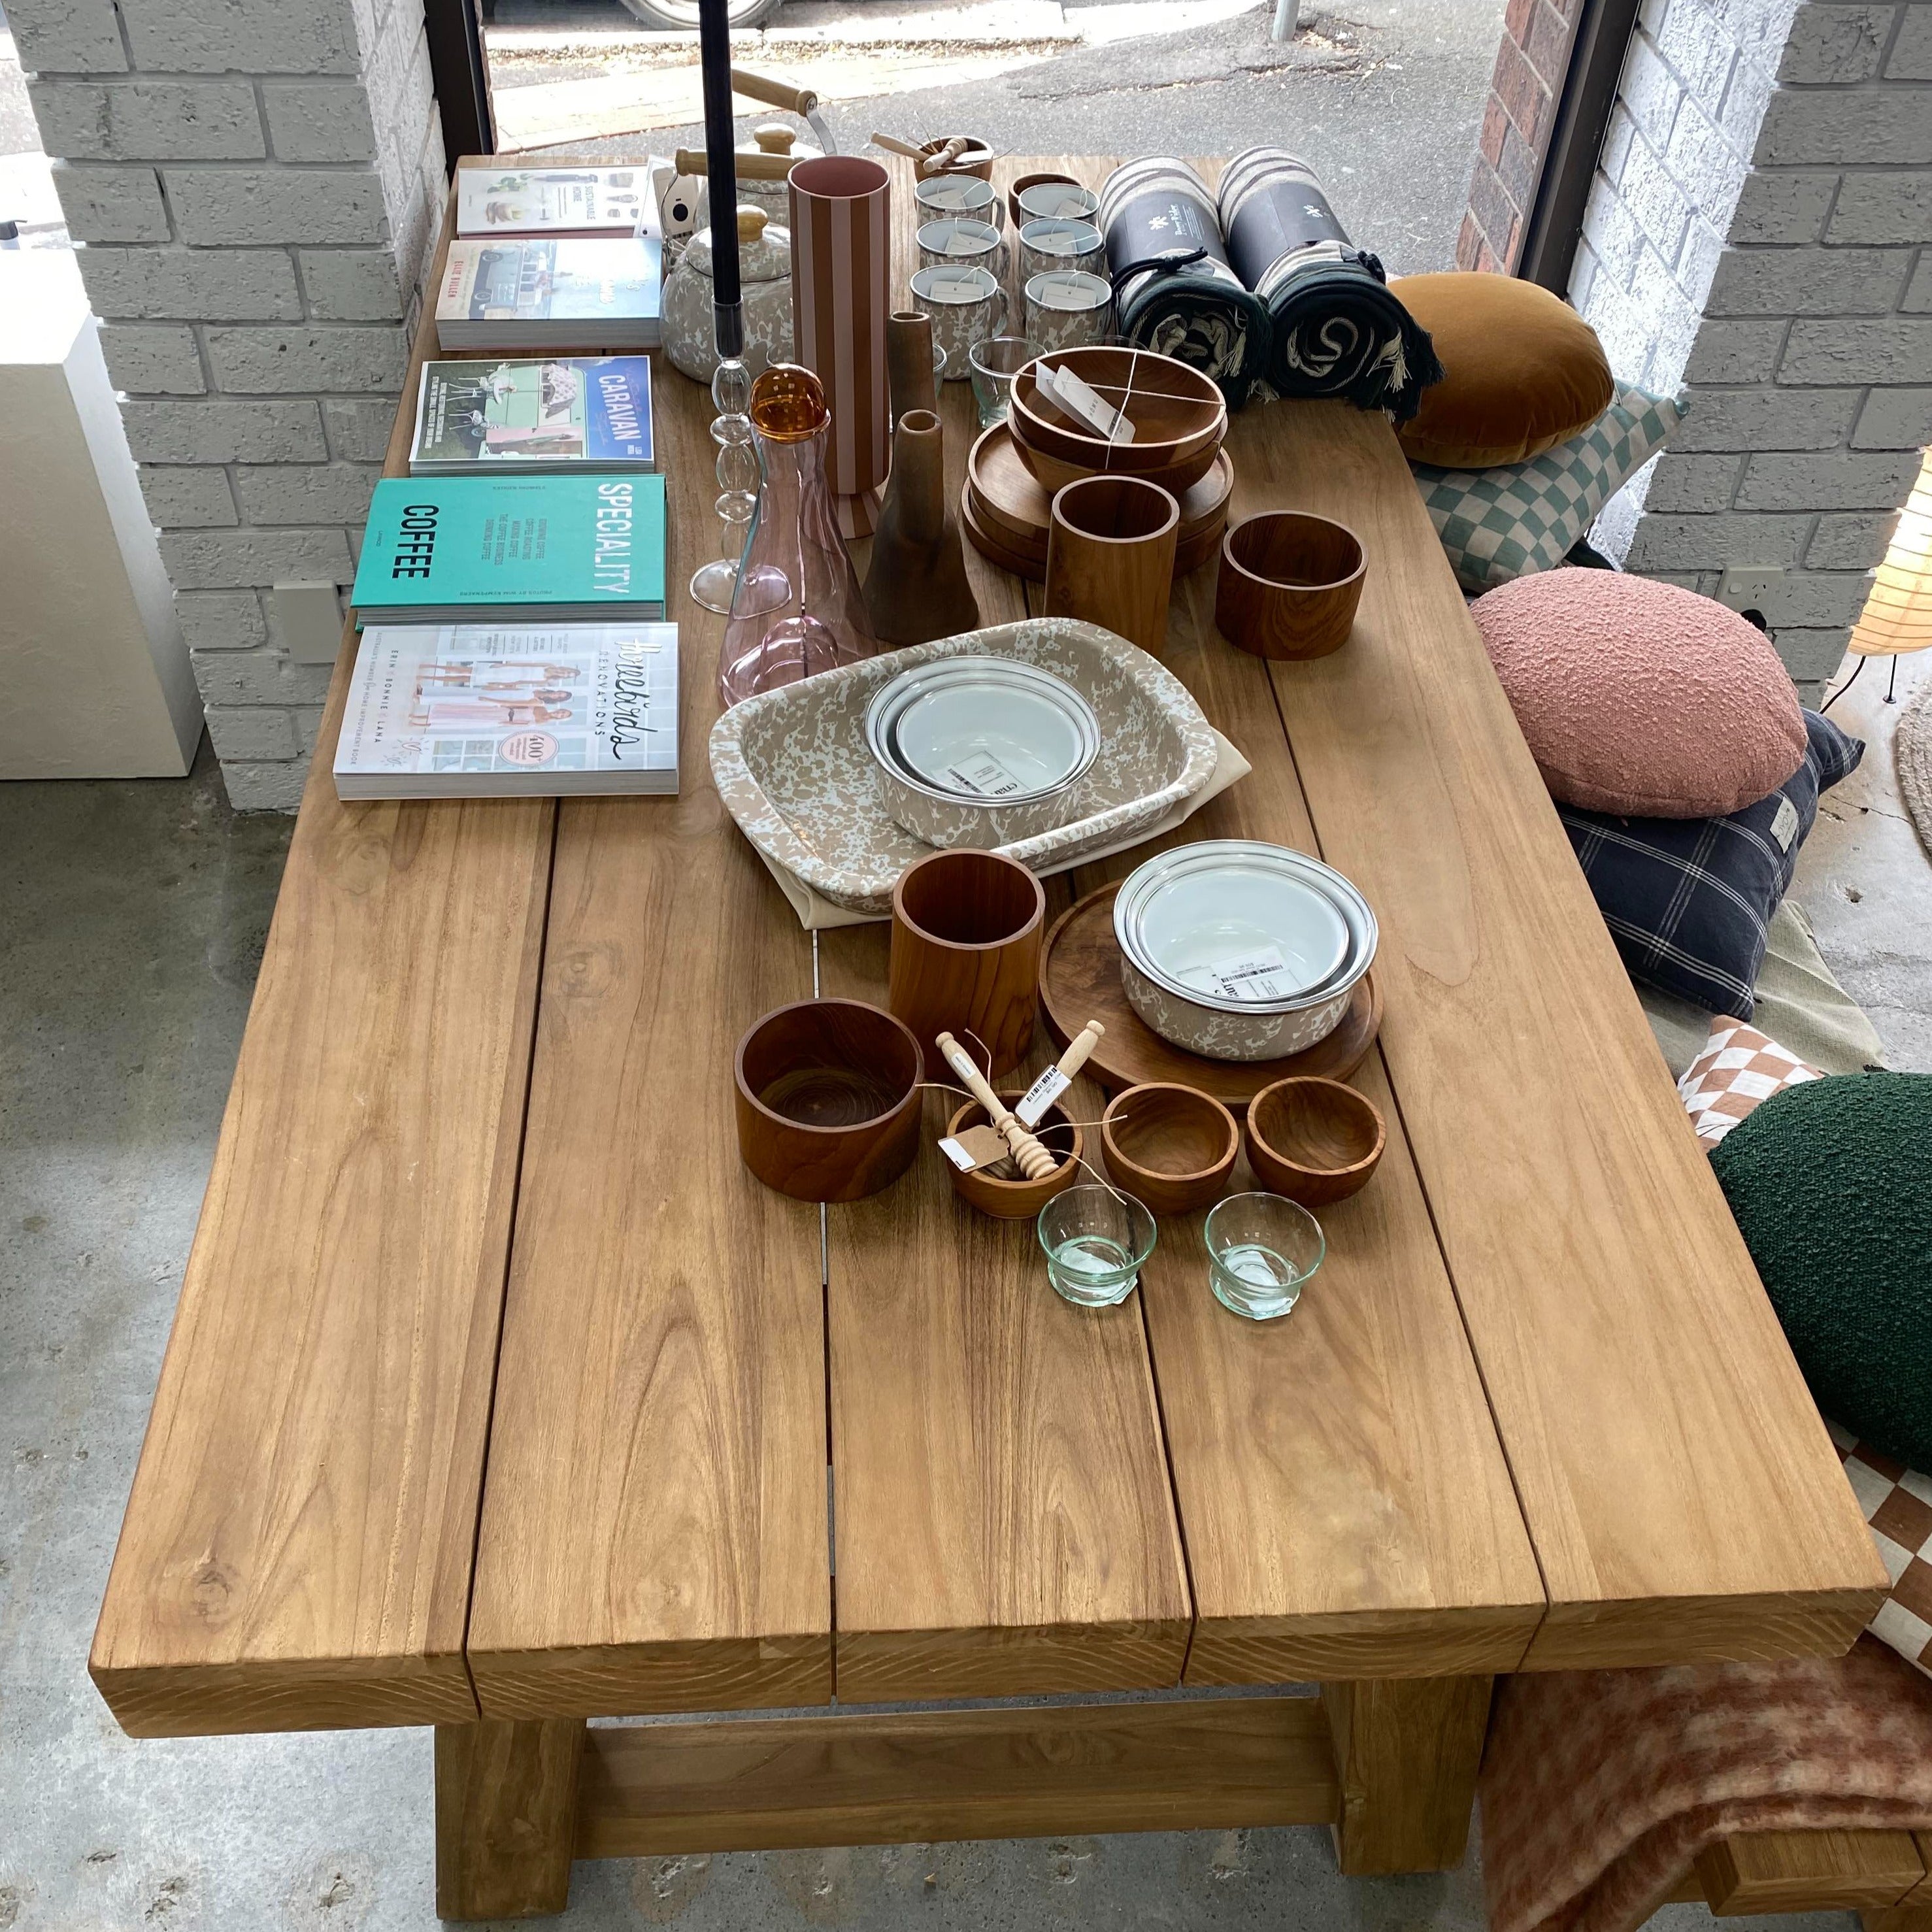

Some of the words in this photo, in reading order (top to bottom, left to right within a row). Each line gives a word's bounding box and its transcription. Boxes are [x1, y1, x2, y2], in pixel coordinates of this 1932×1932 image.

[452, 260, 464, 275] ELLIE
[598, 375, 642, 441] CARAVAN
[499, 514, 509, 523] THE
[524, 518, 535, 536] COFFEE
[391, 504, 439, 579] COFFEE
[497, 523, 508, 541] COFFEE
[593, 482, 633, 594] SPECIALITY
[482, 542, 492, 561] COFFEE
[494, 542, 506, 566] BUSINESS
[508, 540, 519, 558] COFFEE
[536, 541, 546, 560] COFFEE
[371, 632, 383, 660] AUSTRALIA'S
[389, 650, 399, 668] ERIN
[367, 660, 377, 681] NUMBER
[361, 691, 371, 708] HOME
[380, 678, 393, 710] BONNIE
[595, 650, 609, 736] RENOVATIONS
[354, 708, 368, 747] IMPROVEMENT
[374, 721, 386, 743] LANA
[350, 748, 361, 766] BOOK
